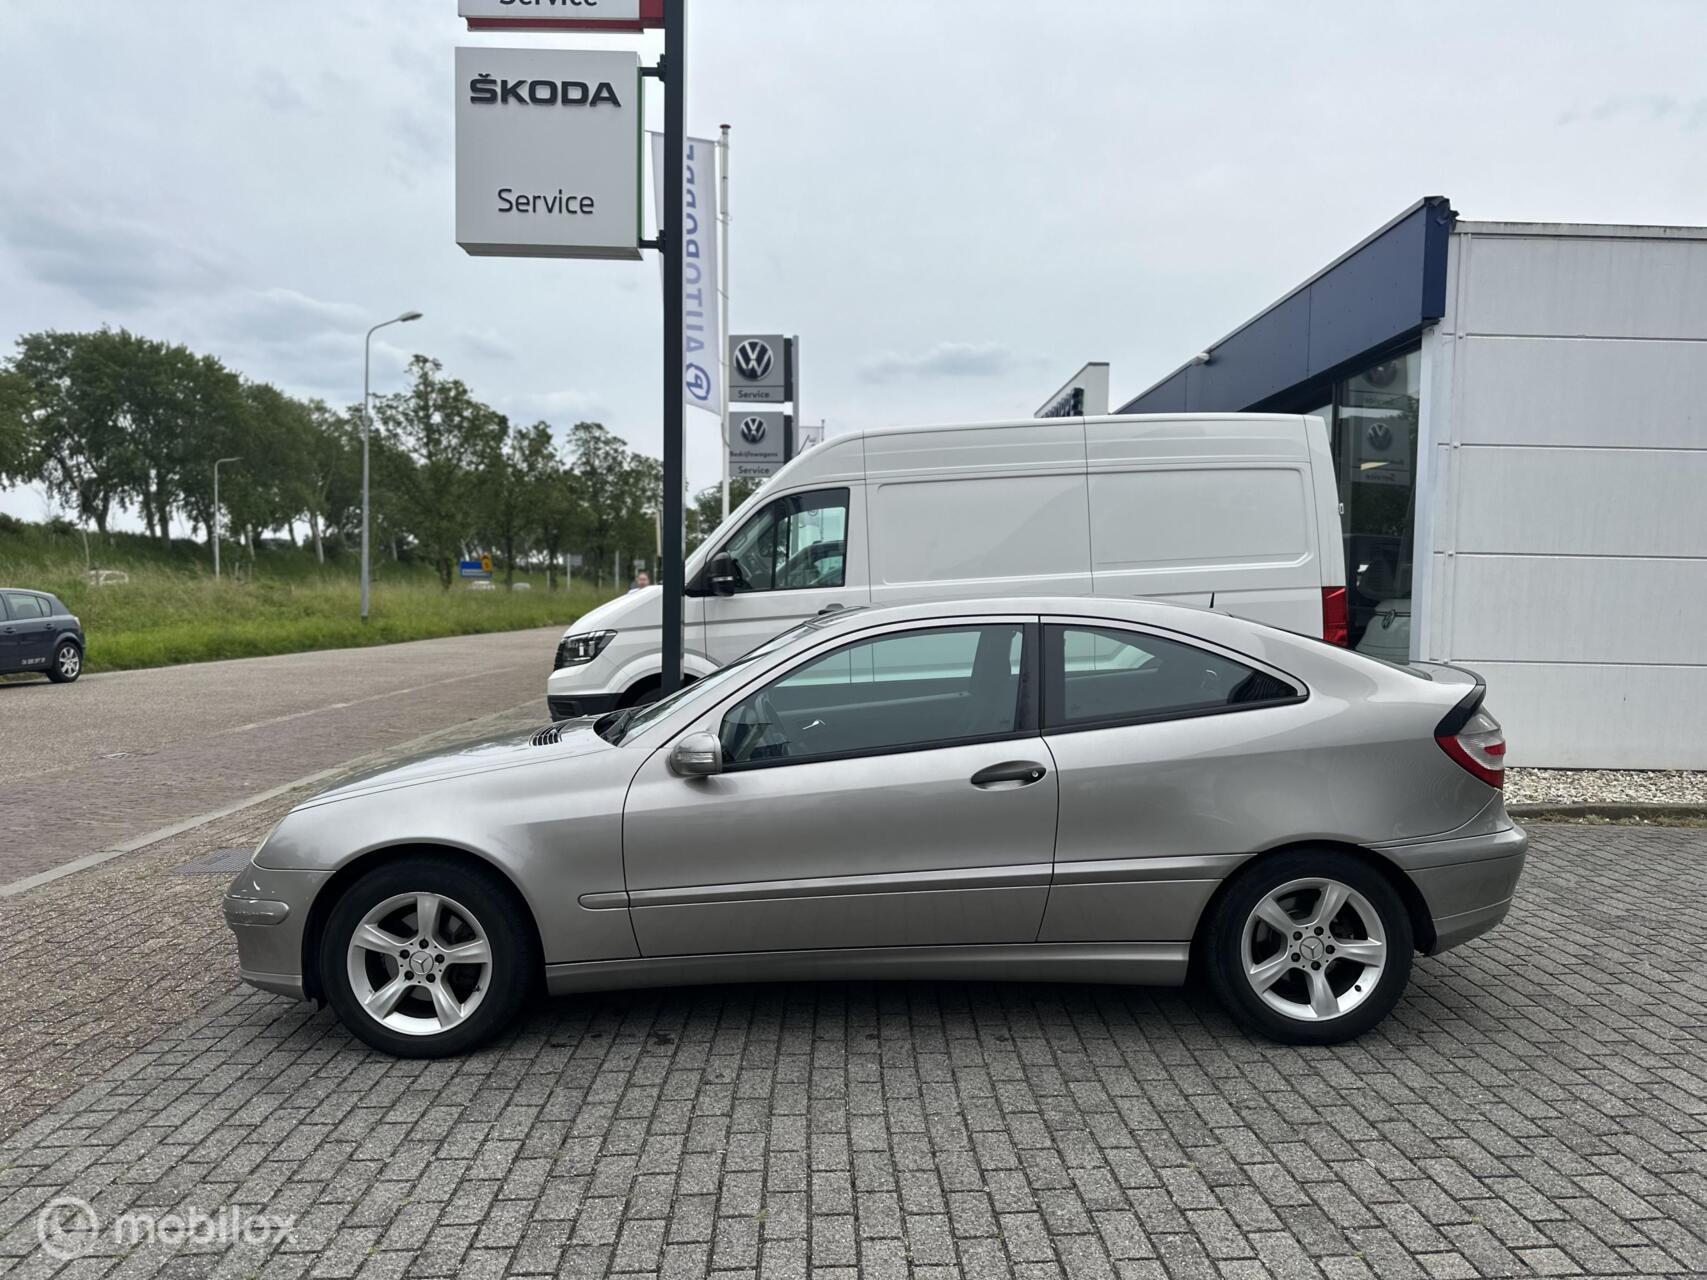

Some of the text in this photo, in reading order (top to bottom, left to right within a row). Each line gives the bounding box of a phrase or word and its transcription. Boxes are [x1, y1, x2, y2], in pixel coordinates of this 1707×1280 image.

[470, 73, 621, 107] ŠKODA
[498, 188, 595, 214] Service
[738, 390, 770, 399] Service
[738, 466, 770, 474] Service
